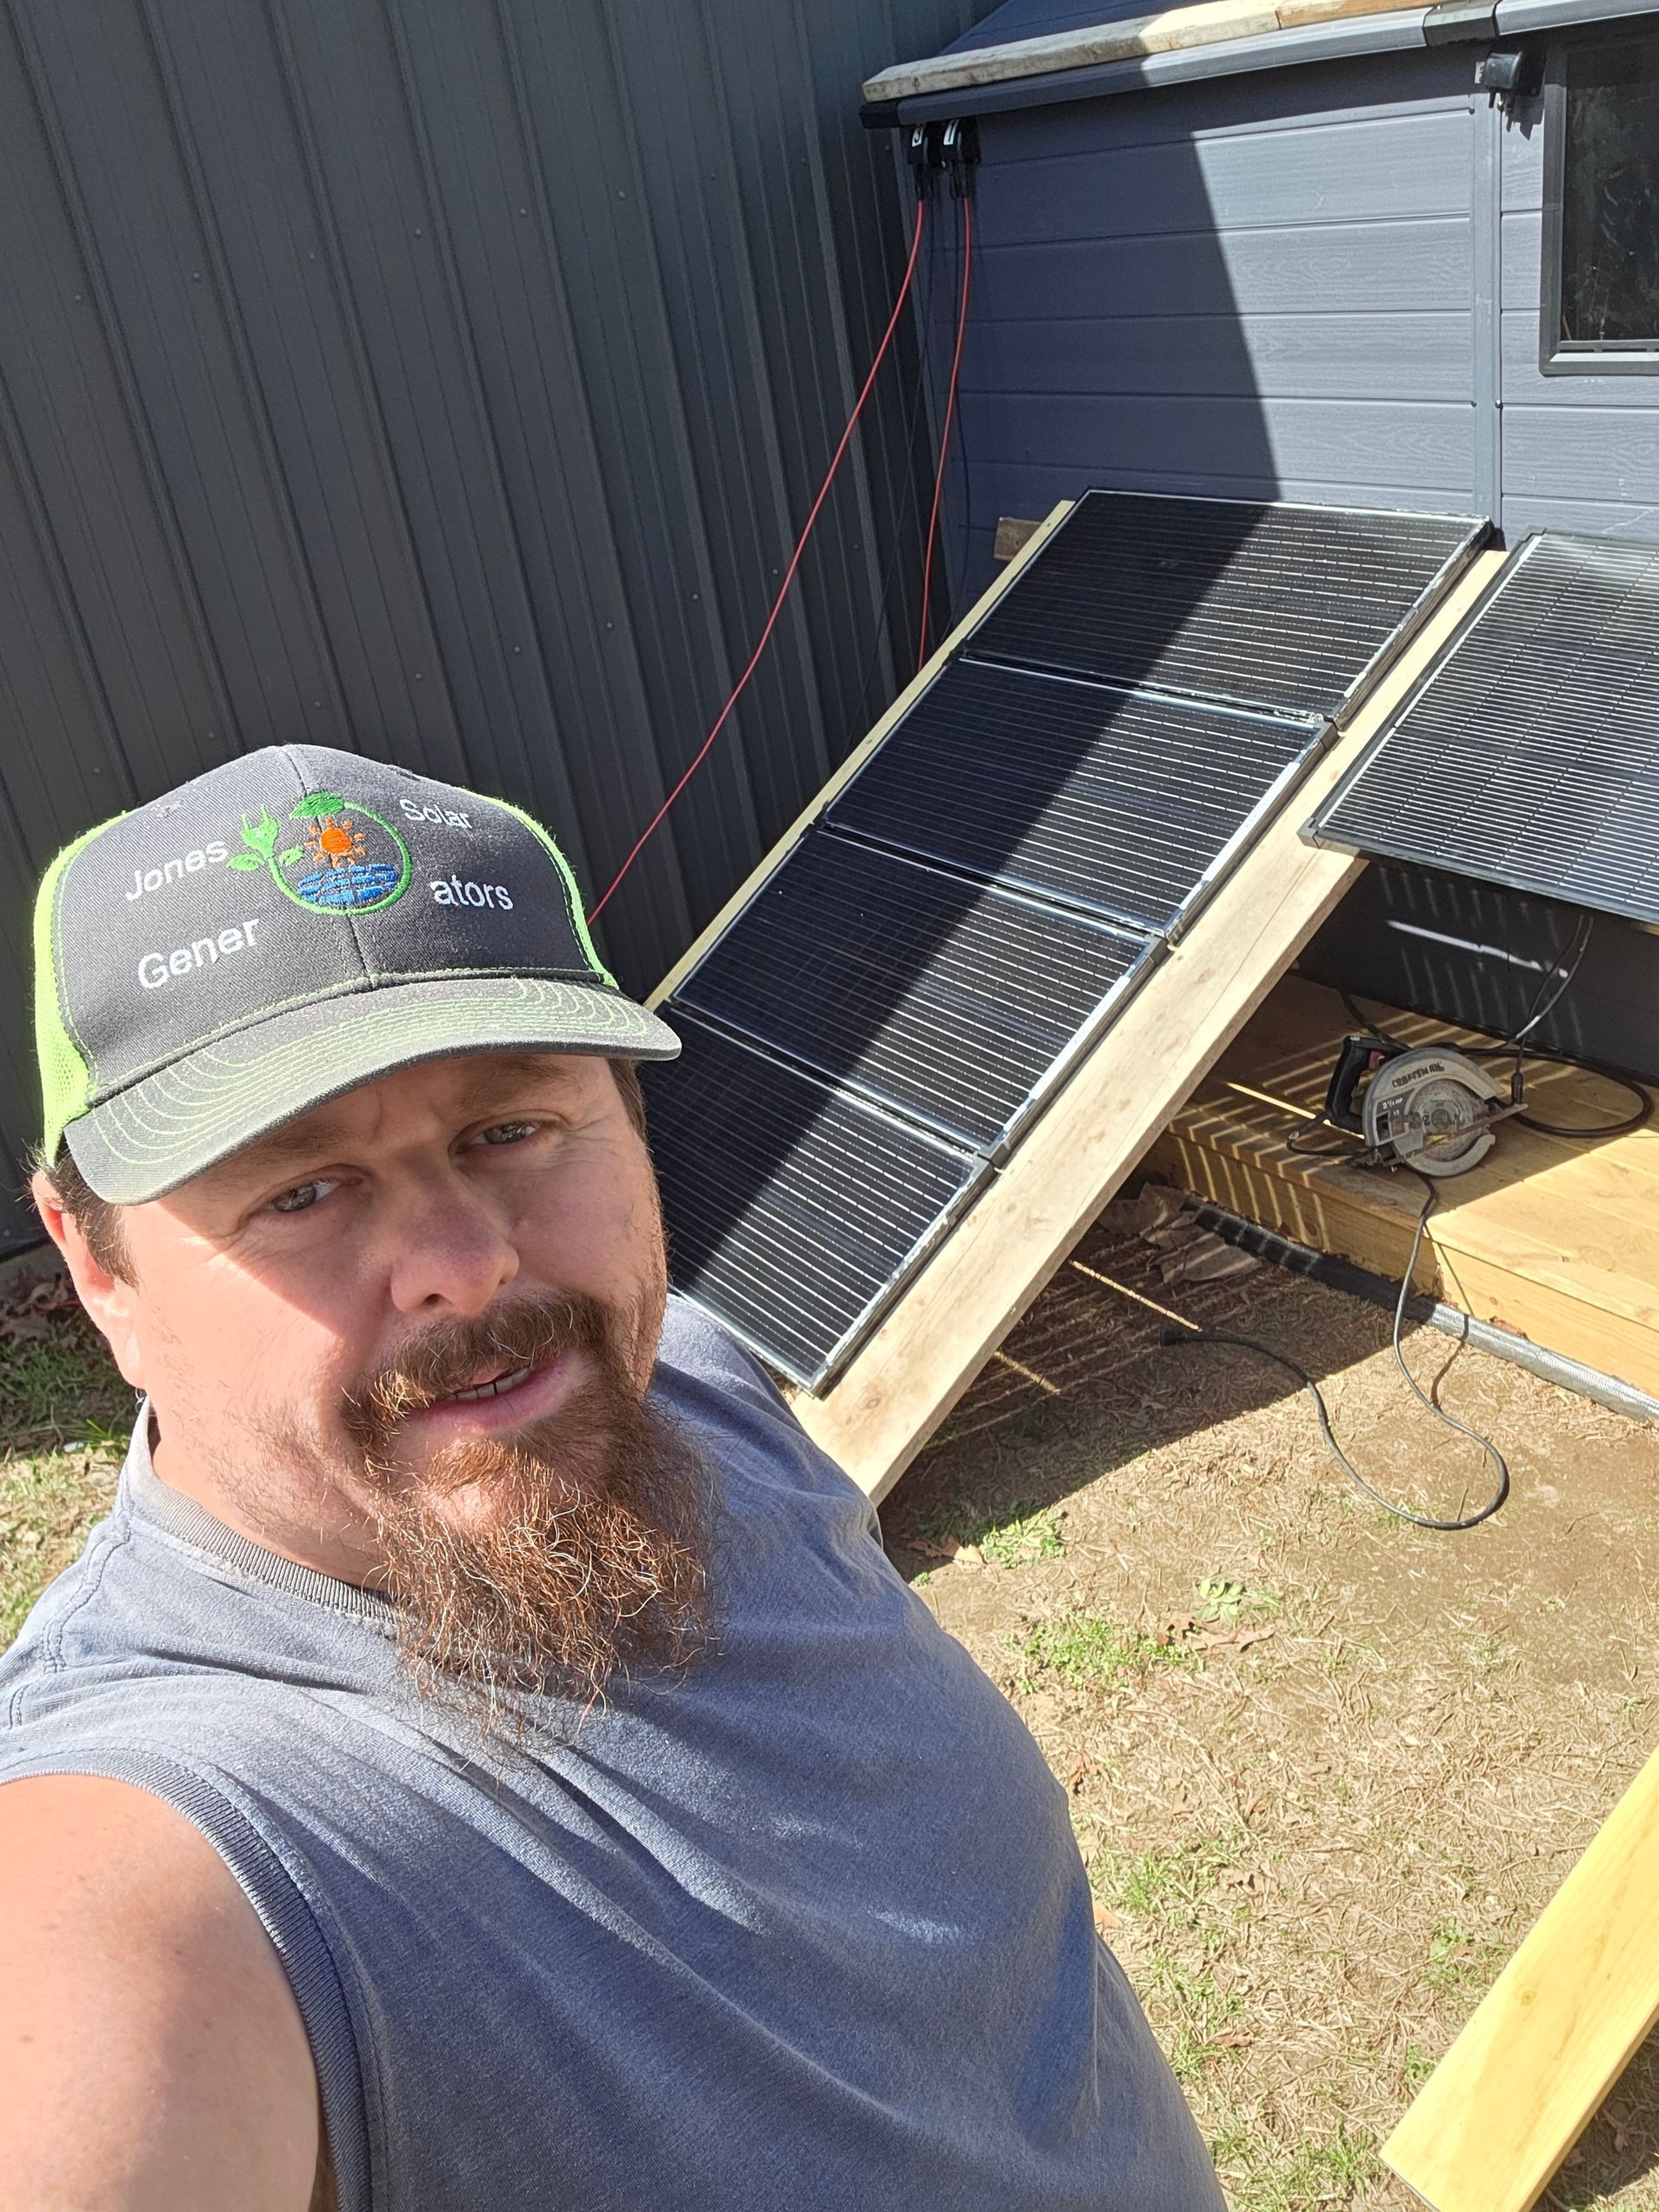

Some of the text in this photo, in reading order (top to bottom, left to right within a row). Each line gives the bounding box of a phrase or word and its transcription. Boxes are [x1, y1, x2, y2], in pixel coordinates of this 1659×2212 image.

[125, 798, 472, 901] Jones Solar
[137, 874, 514, 989] Gener ators
[1392, 1061, 1445, 1088] CRAFTSMAN
